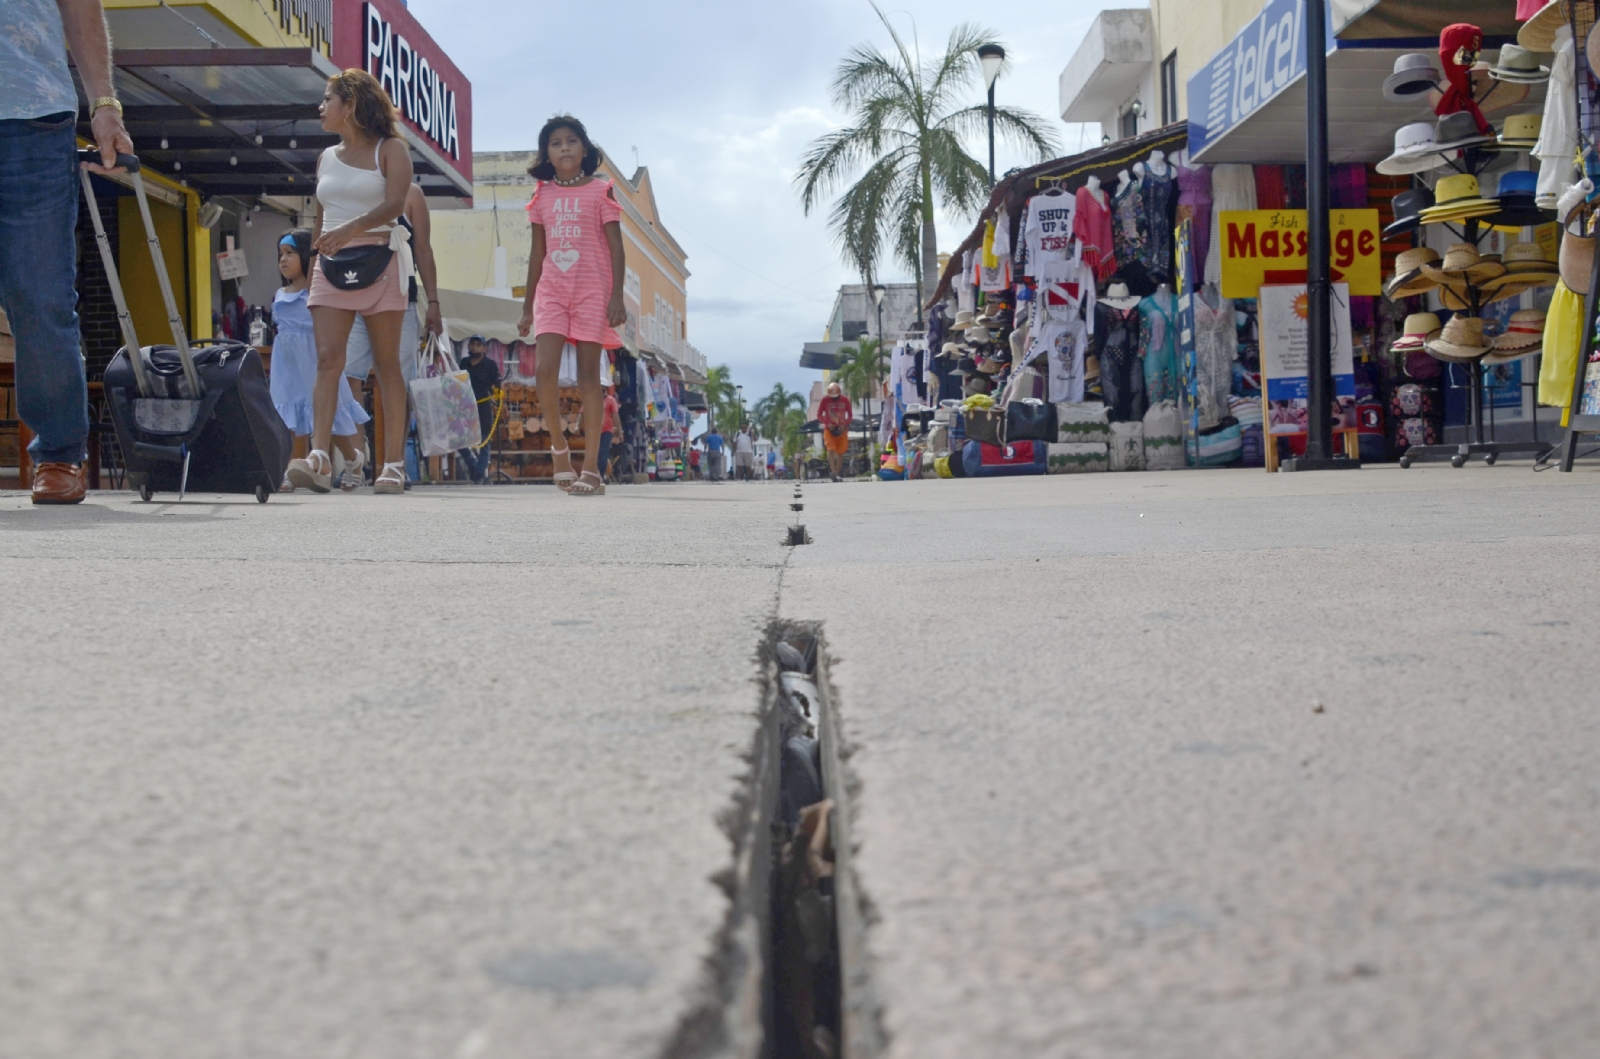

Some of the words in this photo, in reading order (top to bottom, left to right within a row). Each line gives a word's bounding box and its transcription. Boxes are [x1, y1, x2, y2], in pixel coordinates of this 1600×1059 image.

[1231, 0, 1302, 123] telcel
[366, 2, 460, 161] PARISINA
[552, 197, 582, 213] ALL
[555, 213, 580, 226] you
[1038, 209, 1070, 221] SHUT
[1269, 212, 1298, 228] Fish
[1338, 214, 1346, 226] &
[551, 226, 581, 238] NEED
[1041, 222, 1056, 233] UP
[1060, 222, 1068, 232] &
[560, 237, 573, 249] is
[1227, 222, 1375, 268] Massge
[554, 252, 575, 264] love
